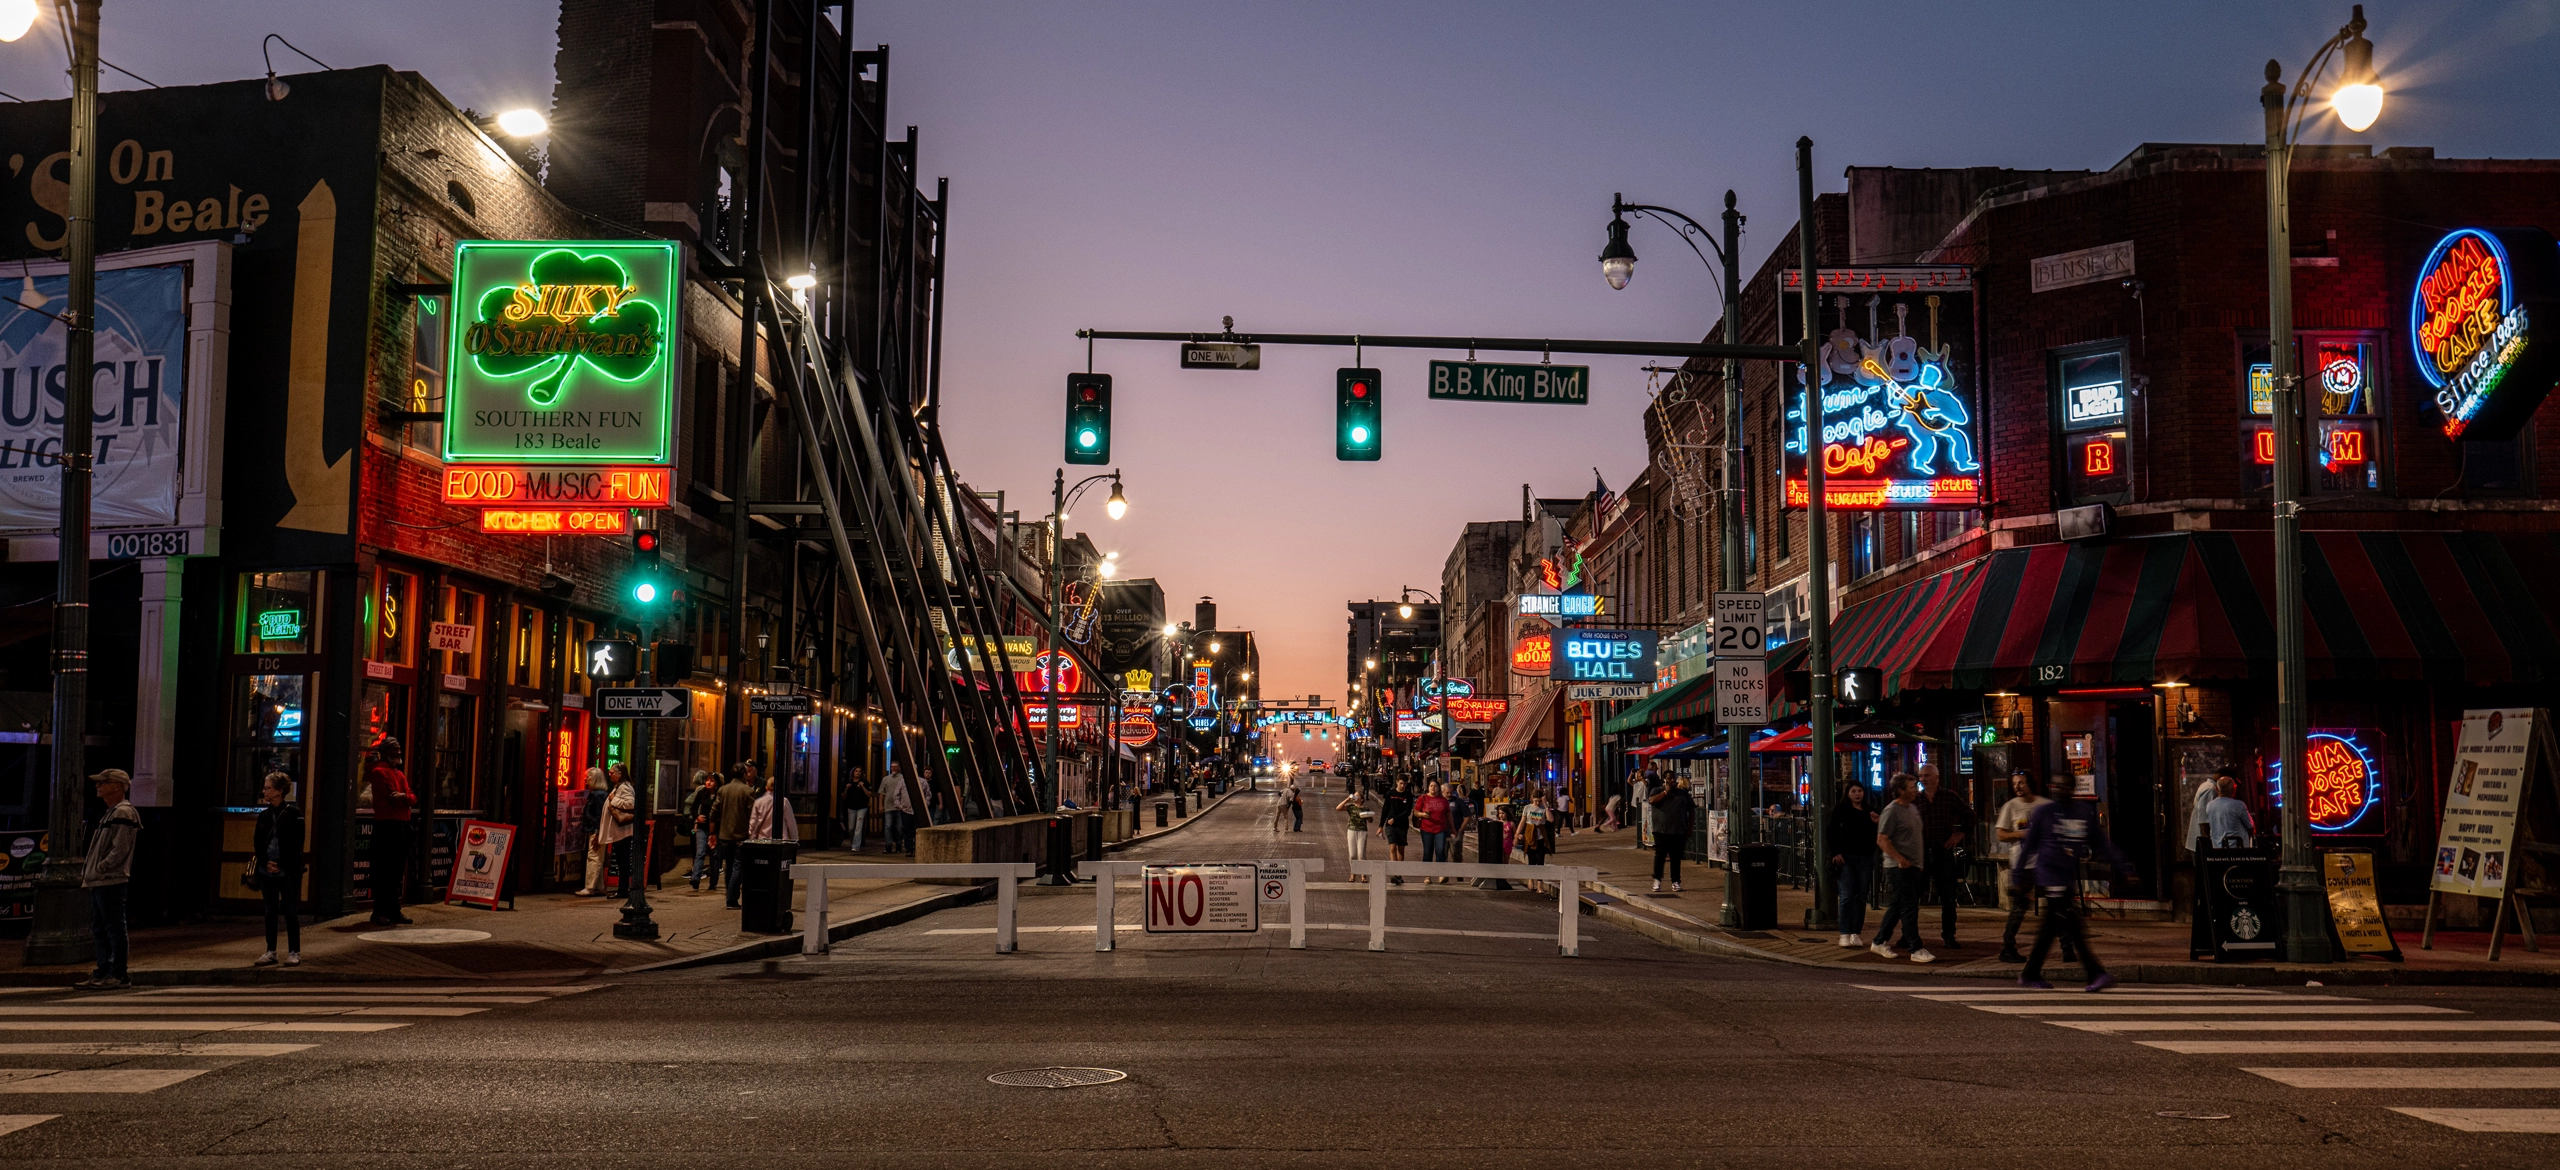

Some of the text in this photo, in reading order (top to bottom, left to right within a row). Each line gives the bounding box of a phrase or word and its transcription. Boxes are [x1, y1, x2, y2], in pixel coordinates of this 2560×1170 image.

[109, 139, 174, 185] On
[132, 184, 270, 236] Beale
[2420, 237, 2481, 313] RUM
[505, 284, 637, 323] SILKY
[2419, 256, 2496, 353] BOOGIE
[2437, 299, 2494, 373] CAFE
[1190, 350, 1237, 363] ONE WAY
[1435, 366, 1584, 400] B.B. King Blvd.
[2252, 377, 2273, 389] TIN
[2437, 350, 2490, 414] Since
[0, 360, 162, 427] USCH
[2079, 385, 2119, 404] BUD
[2253, 390, 2273, 402] BOM
[2073, 399, 2123, 416] LIGHT
[474, 410, 643, 428] SOUTHERN FUN
[514, 433, 601, 450] 183 Beale
[0, 434, 117, 468] LIGT
[1824, 437, 1891, 474] Cafe
[1892, 483, 1930, 498] BLUES
[1942, 478, 1973, 491] CLUB
[484, 512, 620, 530] KITCHEN OPEN
[110, 532, 188, 557] 001831
[1521, 597, 1594, 614] STRANGE CARGO
[1718, 600, 1762, 610] SPEED
[268, 614, 291, 624] BUD
[1722, 613, 1757, 623] LIMIT
[264, 624, 295, 635] LIGHT
[434, 624, 471, 638] STREET
[439, 638, 461, 650] BAR
[1719, 626, 1761, 650] 20
[1526, 641, 1551, 653] TAP
[1567, 640, 1643, 660] BLUES
[1516, 651, 1552, 663] ROOM
[258, 658, 280, 670] FDC
[368, 665, 393, 676] STREET BAR
[1574, 661, 1634, 679] HALL
[1732, 667, 1749, 677] NO
[2037, 665, 2065, 682] 182
[1718, 680, 1764, 690] TRUCKS
[1574, 686, 1642, 698] JUKE JOINT
[608, 697, 662, 709] ONE WAY
[1734, 694, 1749, 704] OR
[751, 702, 807, 712] Silky O'Sullivan's
[1722, 707, 1762, 717] BUSES
[1455, 710, 1492, 720] CAFE
[1195, 719, 1210, 727] BLUES
[2459, 745, 2469, 753] LIVE
[2469, 745, 2484, 753] MUSIC
[2308, 742, 2352, 772] UM
[2309, 760, 2363, 797] OGIE
[2477, 768, 2490, 776] OVER
[2482, 780, 2502, 789] GUITARS
[2482, 809, 2500, 817] MEMPHIS
[2458, 823, 2494, 834] HAPPY HOUR
[2327, 877, 2372, 887] DOWN HOME
[1151, 872, 1205, 927] NO
